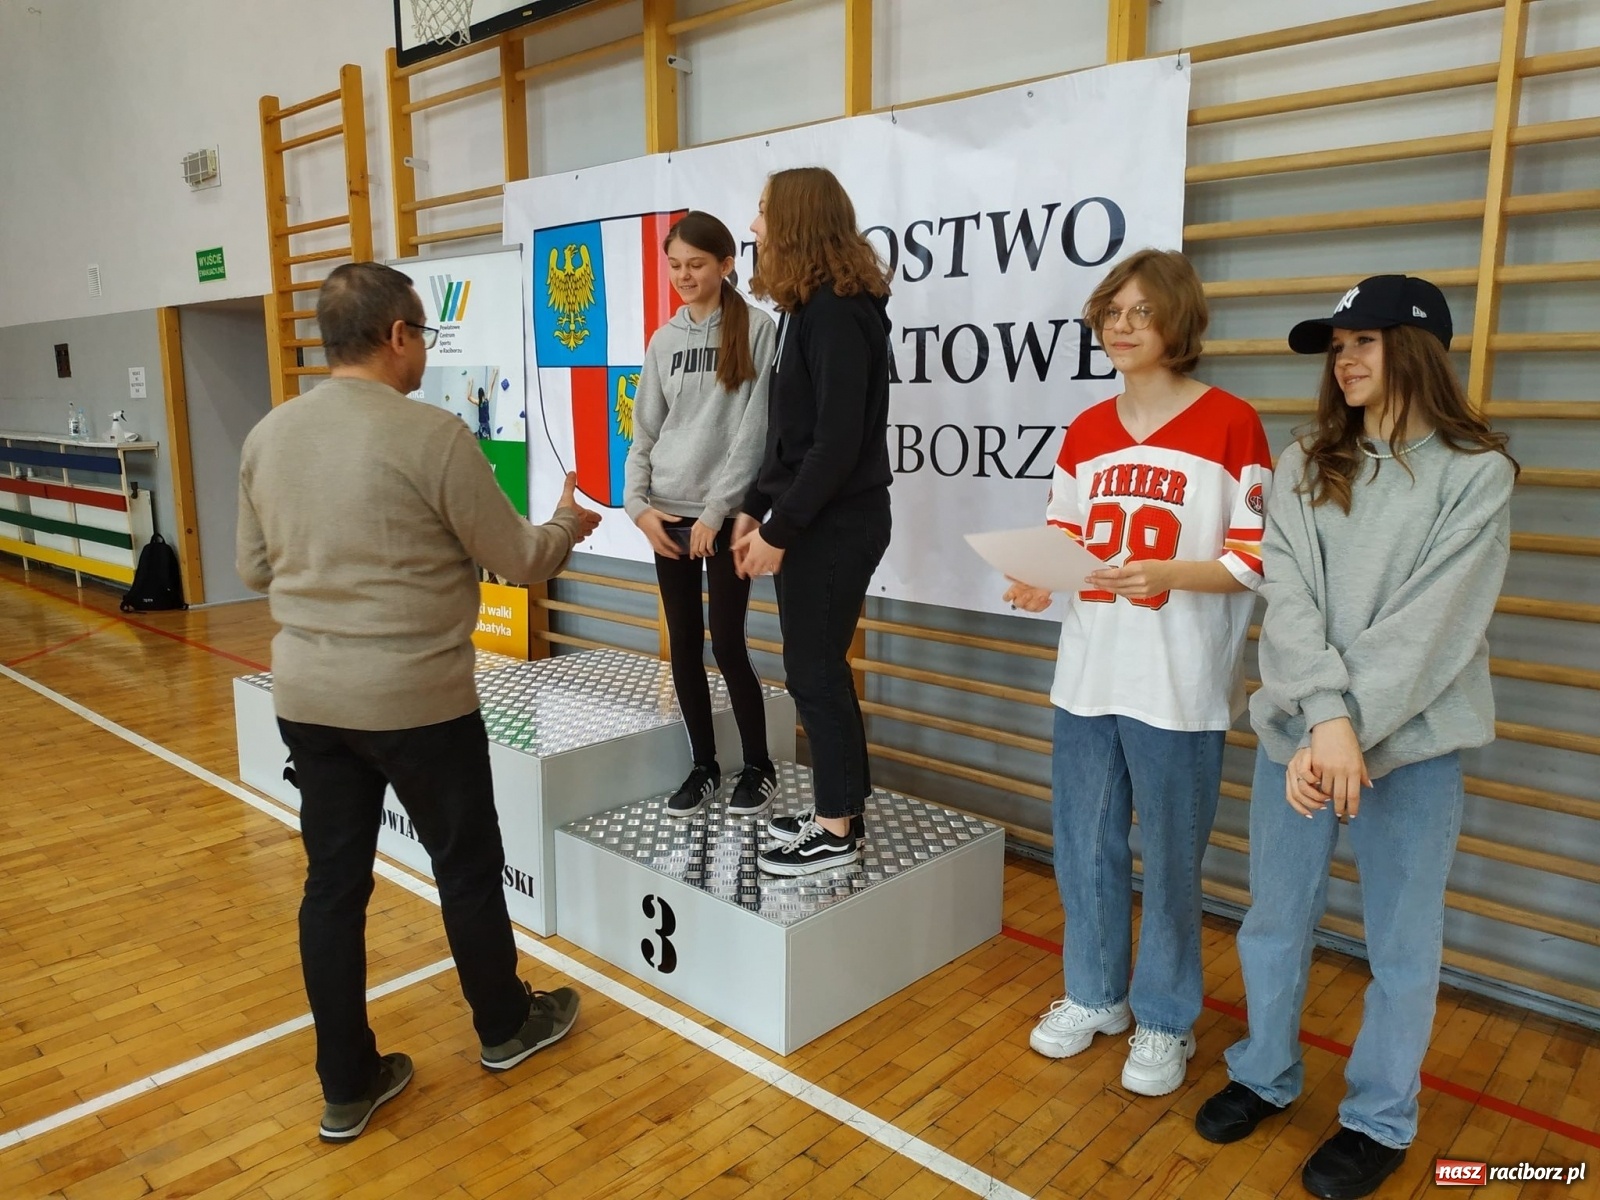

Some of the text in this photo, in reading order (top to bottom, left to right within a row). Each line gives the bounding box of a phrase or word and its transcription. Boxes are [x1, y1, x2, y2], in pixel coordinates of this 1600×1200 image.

[198, 253, 222, 267] WYJŚCIE
[487, 605, 512, 619] walki
[641, 893, 677, 975] 3
